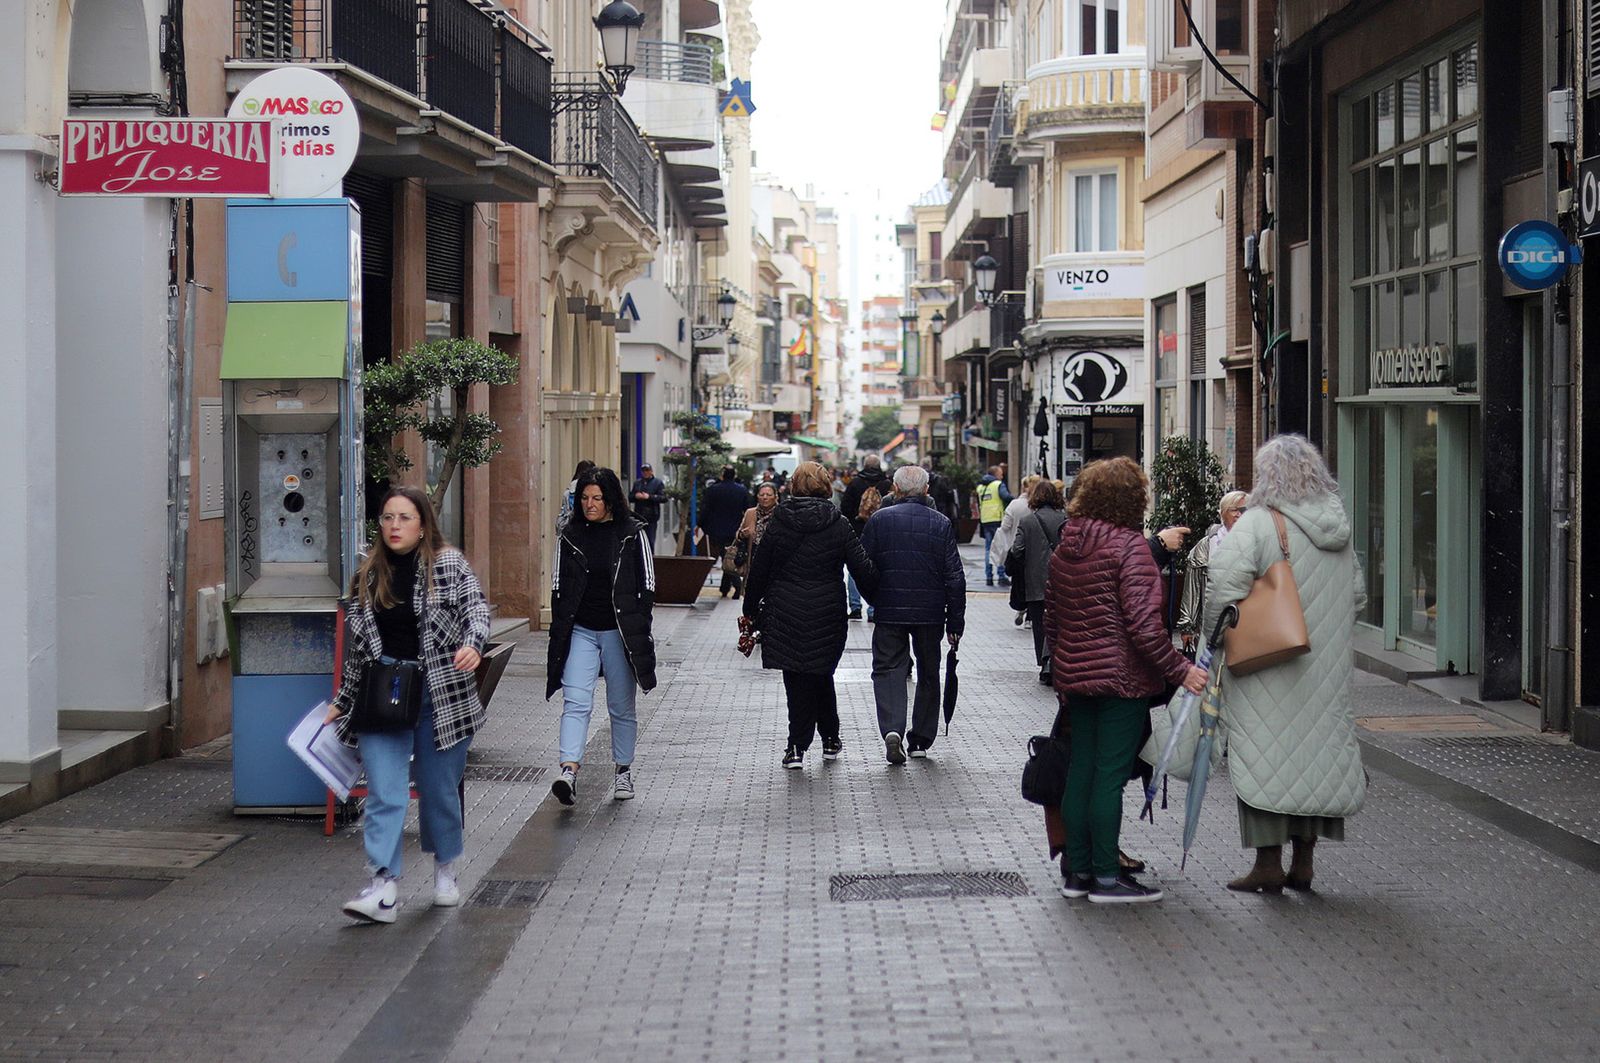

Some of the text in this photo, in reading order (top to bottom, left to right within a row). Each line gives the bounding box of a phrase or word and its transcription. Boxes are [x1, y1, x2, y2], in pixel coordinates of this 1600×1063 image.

[260, 97, 344, 116] MAS&GO
[281, 122, 330, 137] rimos
[66, 121, 267, 164] PELUQUERIA
[293, 139, 335, 156] días
[1507, 250, 1565, 264] DIGI
[1057, 269, 1109, 285] VENZO
[996, 388, 1005, 422] TIGER
